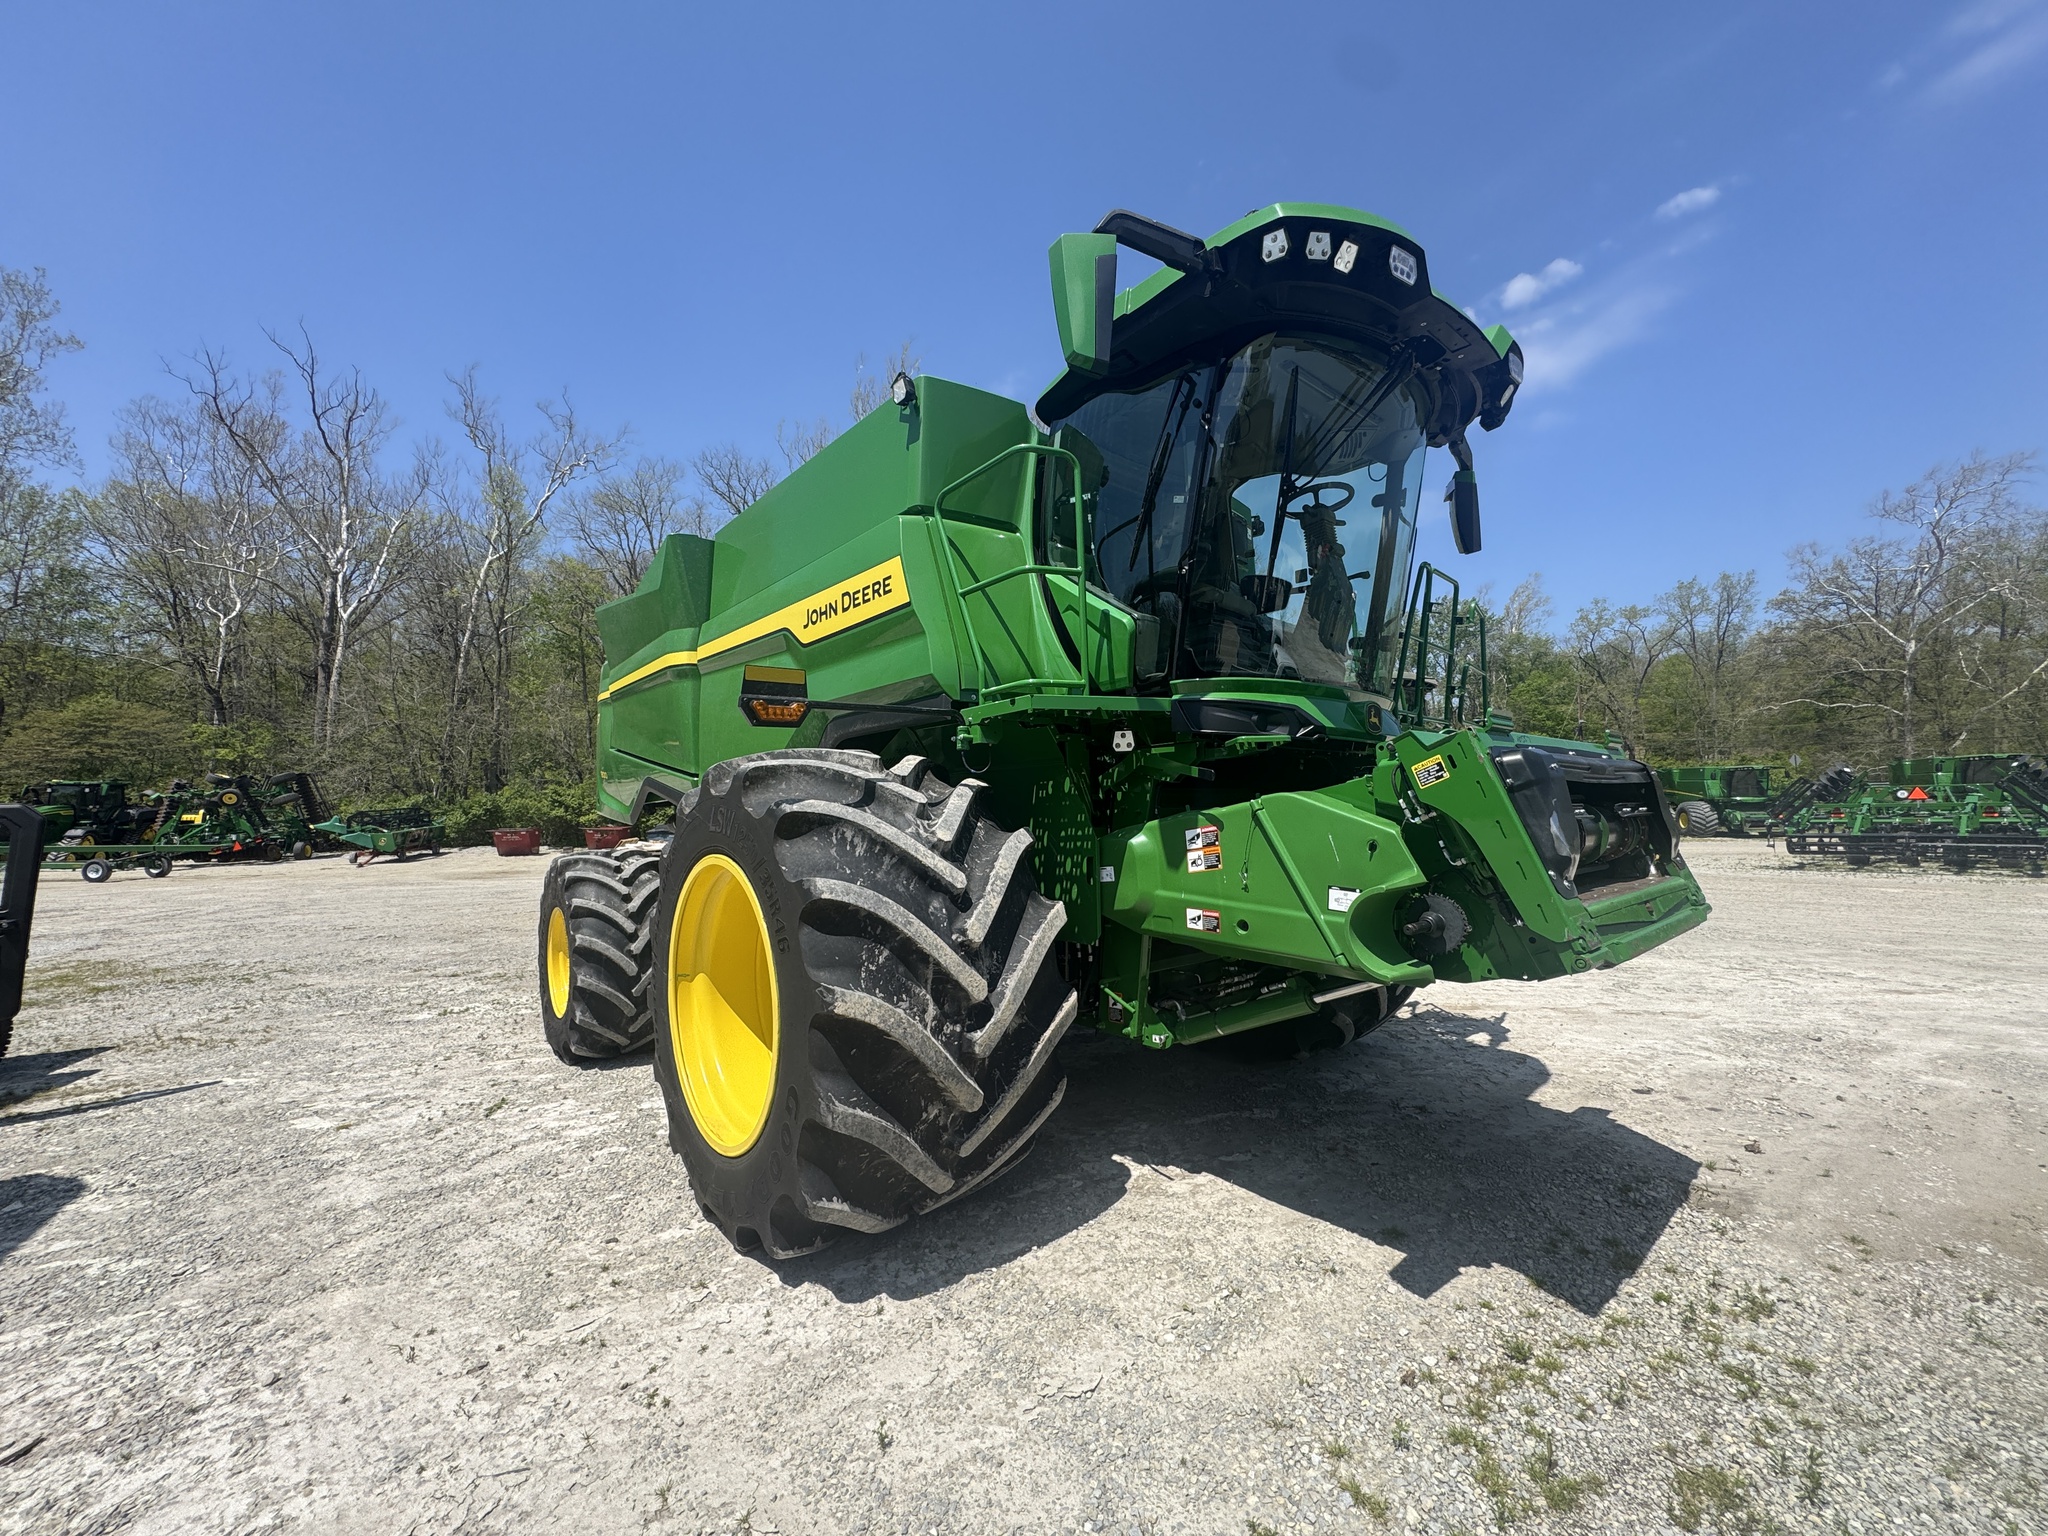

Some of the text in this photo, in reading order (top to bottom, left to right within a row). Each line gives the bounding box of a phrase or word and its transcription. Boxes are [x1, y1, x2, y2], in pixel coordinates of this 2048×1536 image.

[803, 575, 893, 630] JOHN DEERE
[1417, 756, 1441, 770] CAUTION
